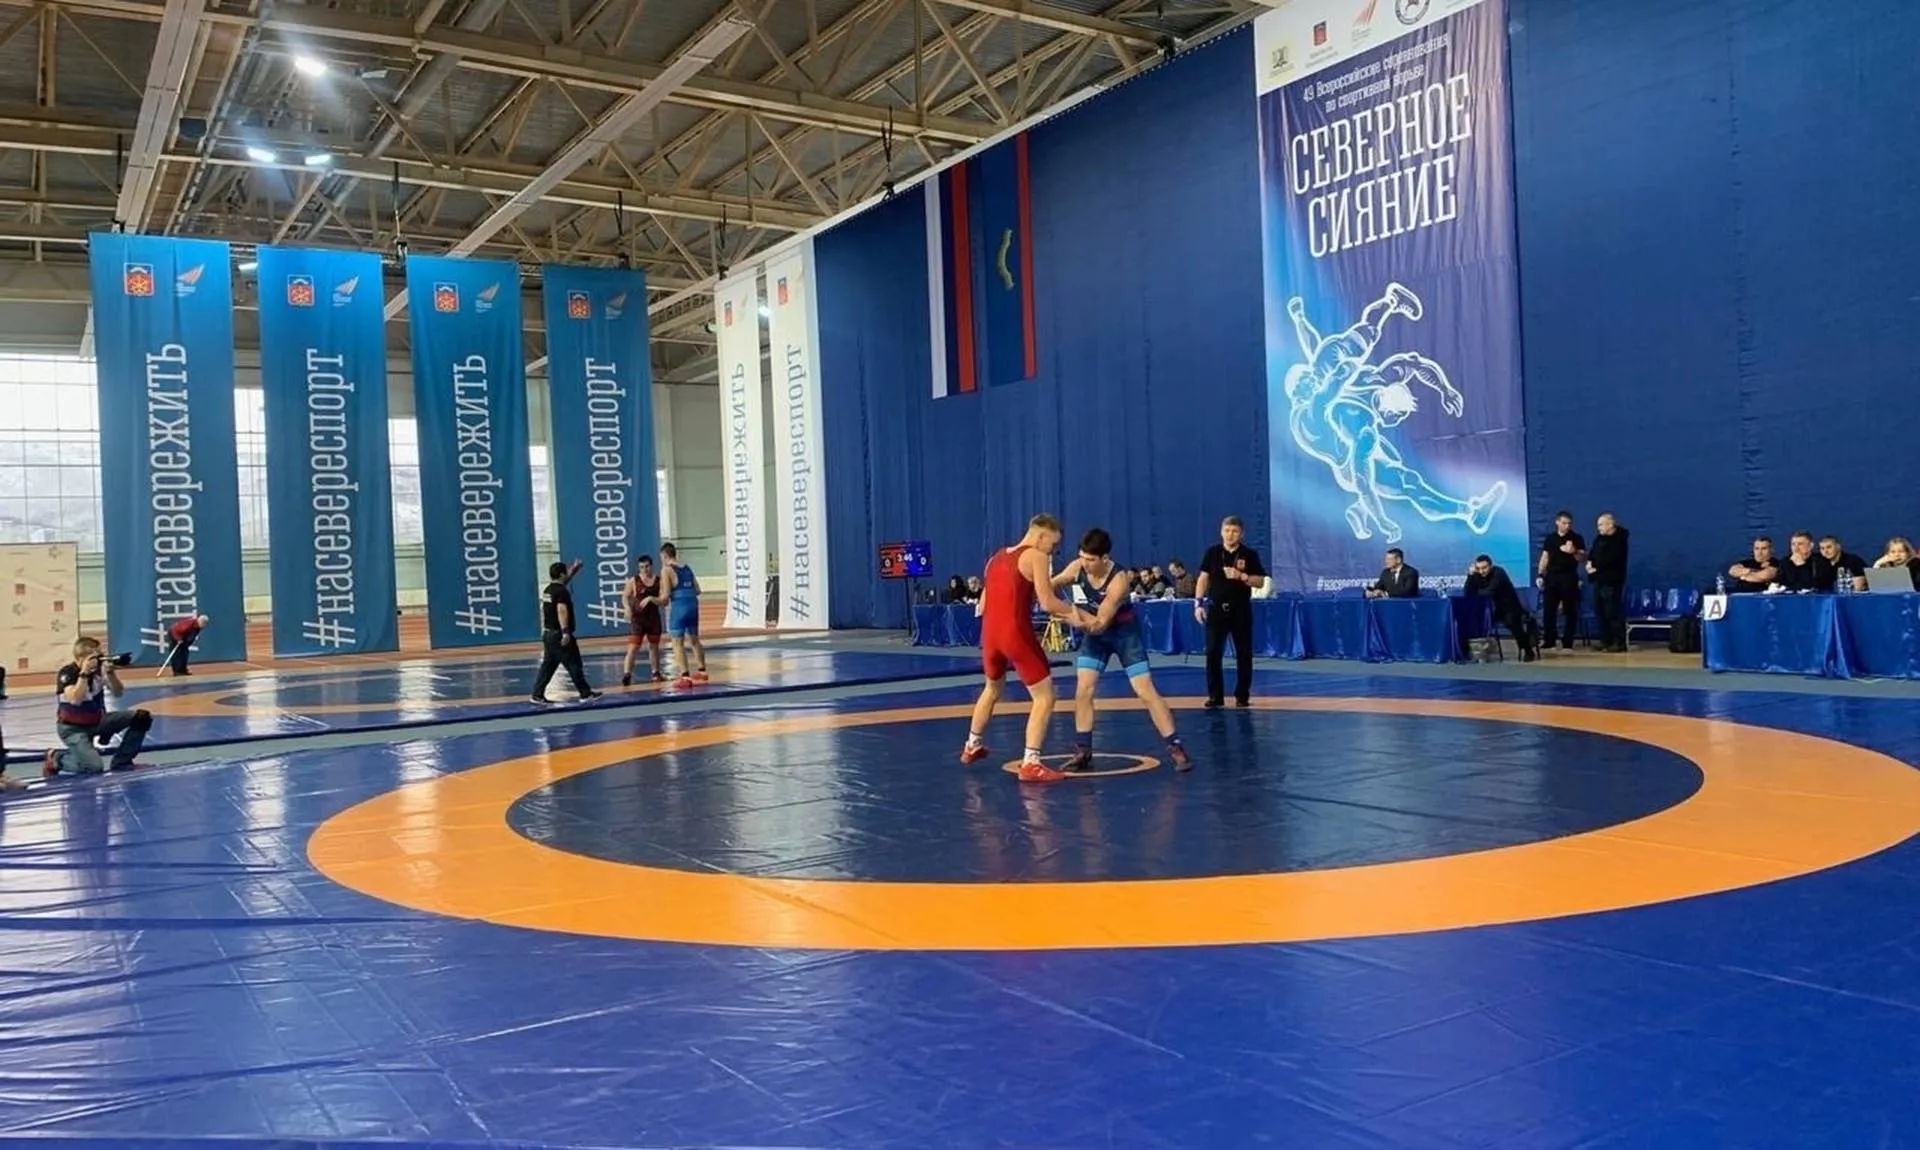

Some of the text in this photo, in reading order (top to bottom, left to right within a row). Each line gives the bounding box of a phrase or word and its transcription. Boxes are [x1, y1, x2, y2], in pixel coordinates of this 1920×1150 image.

[1291, 72, 1472, 195] СЕВЕРНОЕ
[1303, 84, 1314, 102] 49
[1308, 154, 1456, 258] СИЯНИЕ
[141, 342, 203, 654] #насевережить
[302, 348, 359, 648] #насевереспорт
[452, 354, 503, 636] #насевережить
[585, 357, 631, 628] #насевереспорт
[787, 344, 812, 621] #насевереспорт
